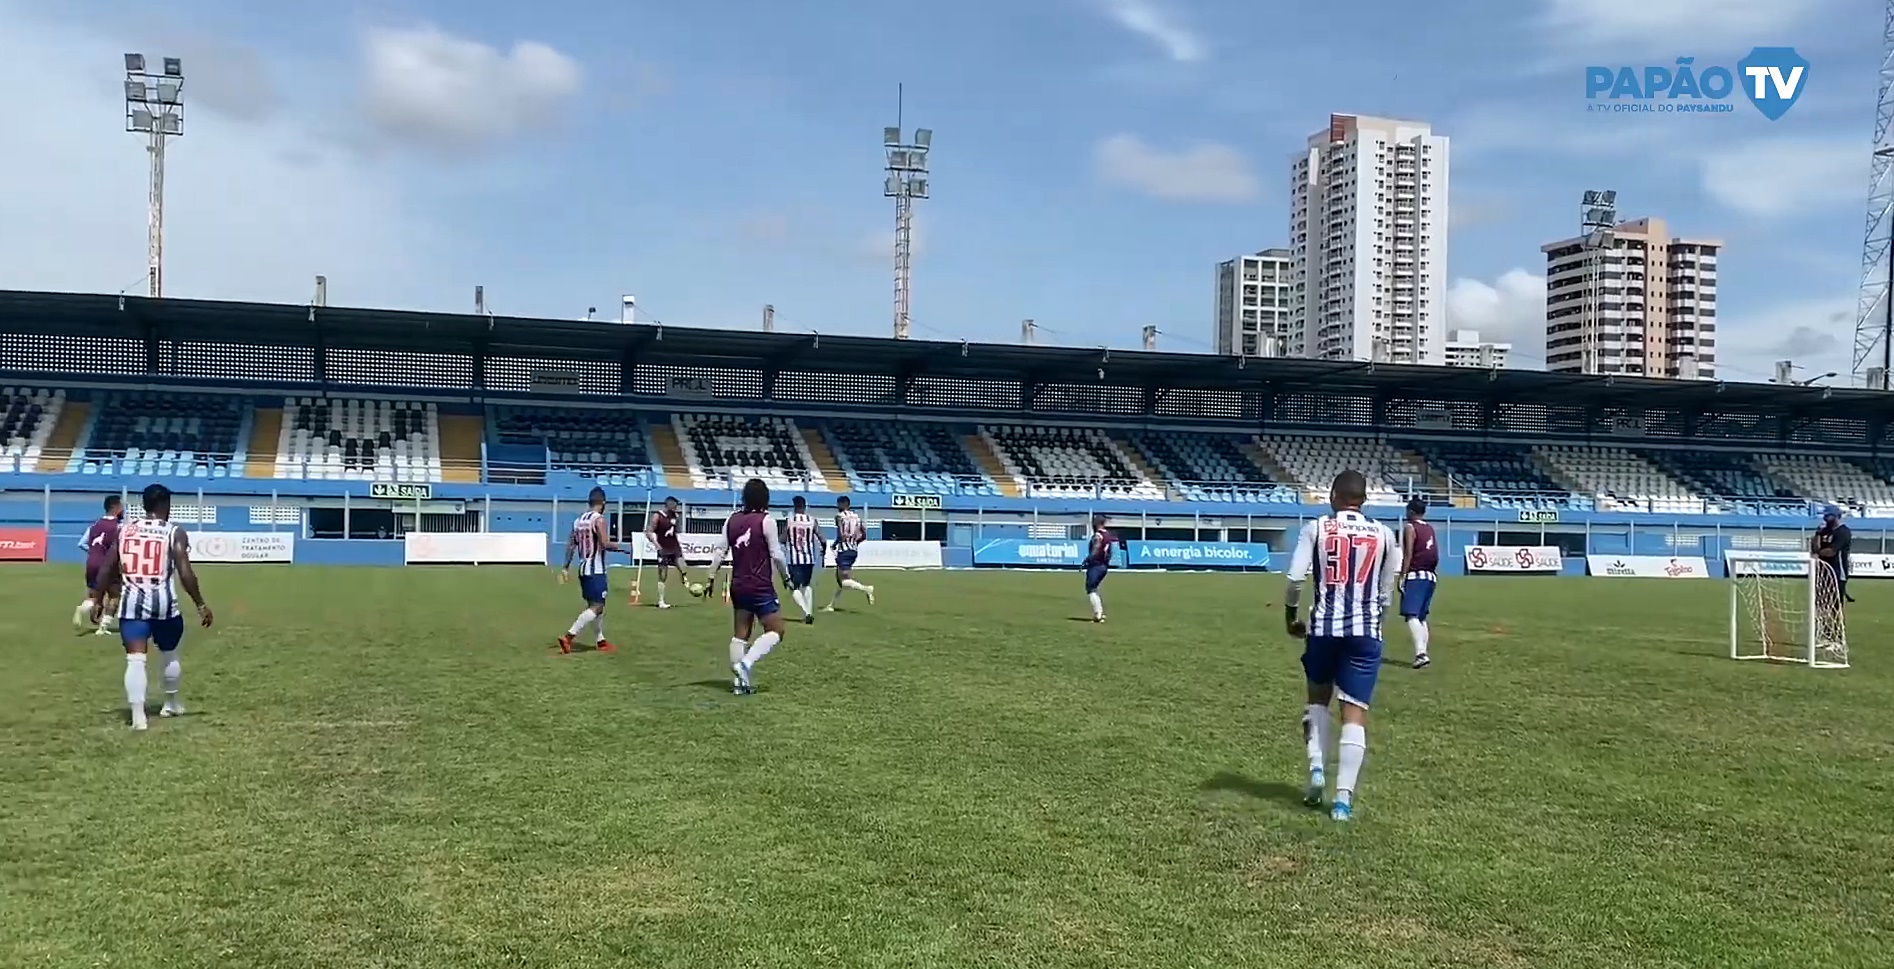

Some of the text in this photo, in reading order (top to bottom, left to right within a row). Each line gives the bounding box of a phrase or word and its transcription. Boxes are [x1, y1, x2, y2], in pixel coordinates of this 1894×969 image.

[242, 537, 270, 545] CENTRO
[1140, 545, 1253, 560] A energia bicolor.
[122, 538, 164, 577] 59
[1324, 535, 1379, 585] 37
